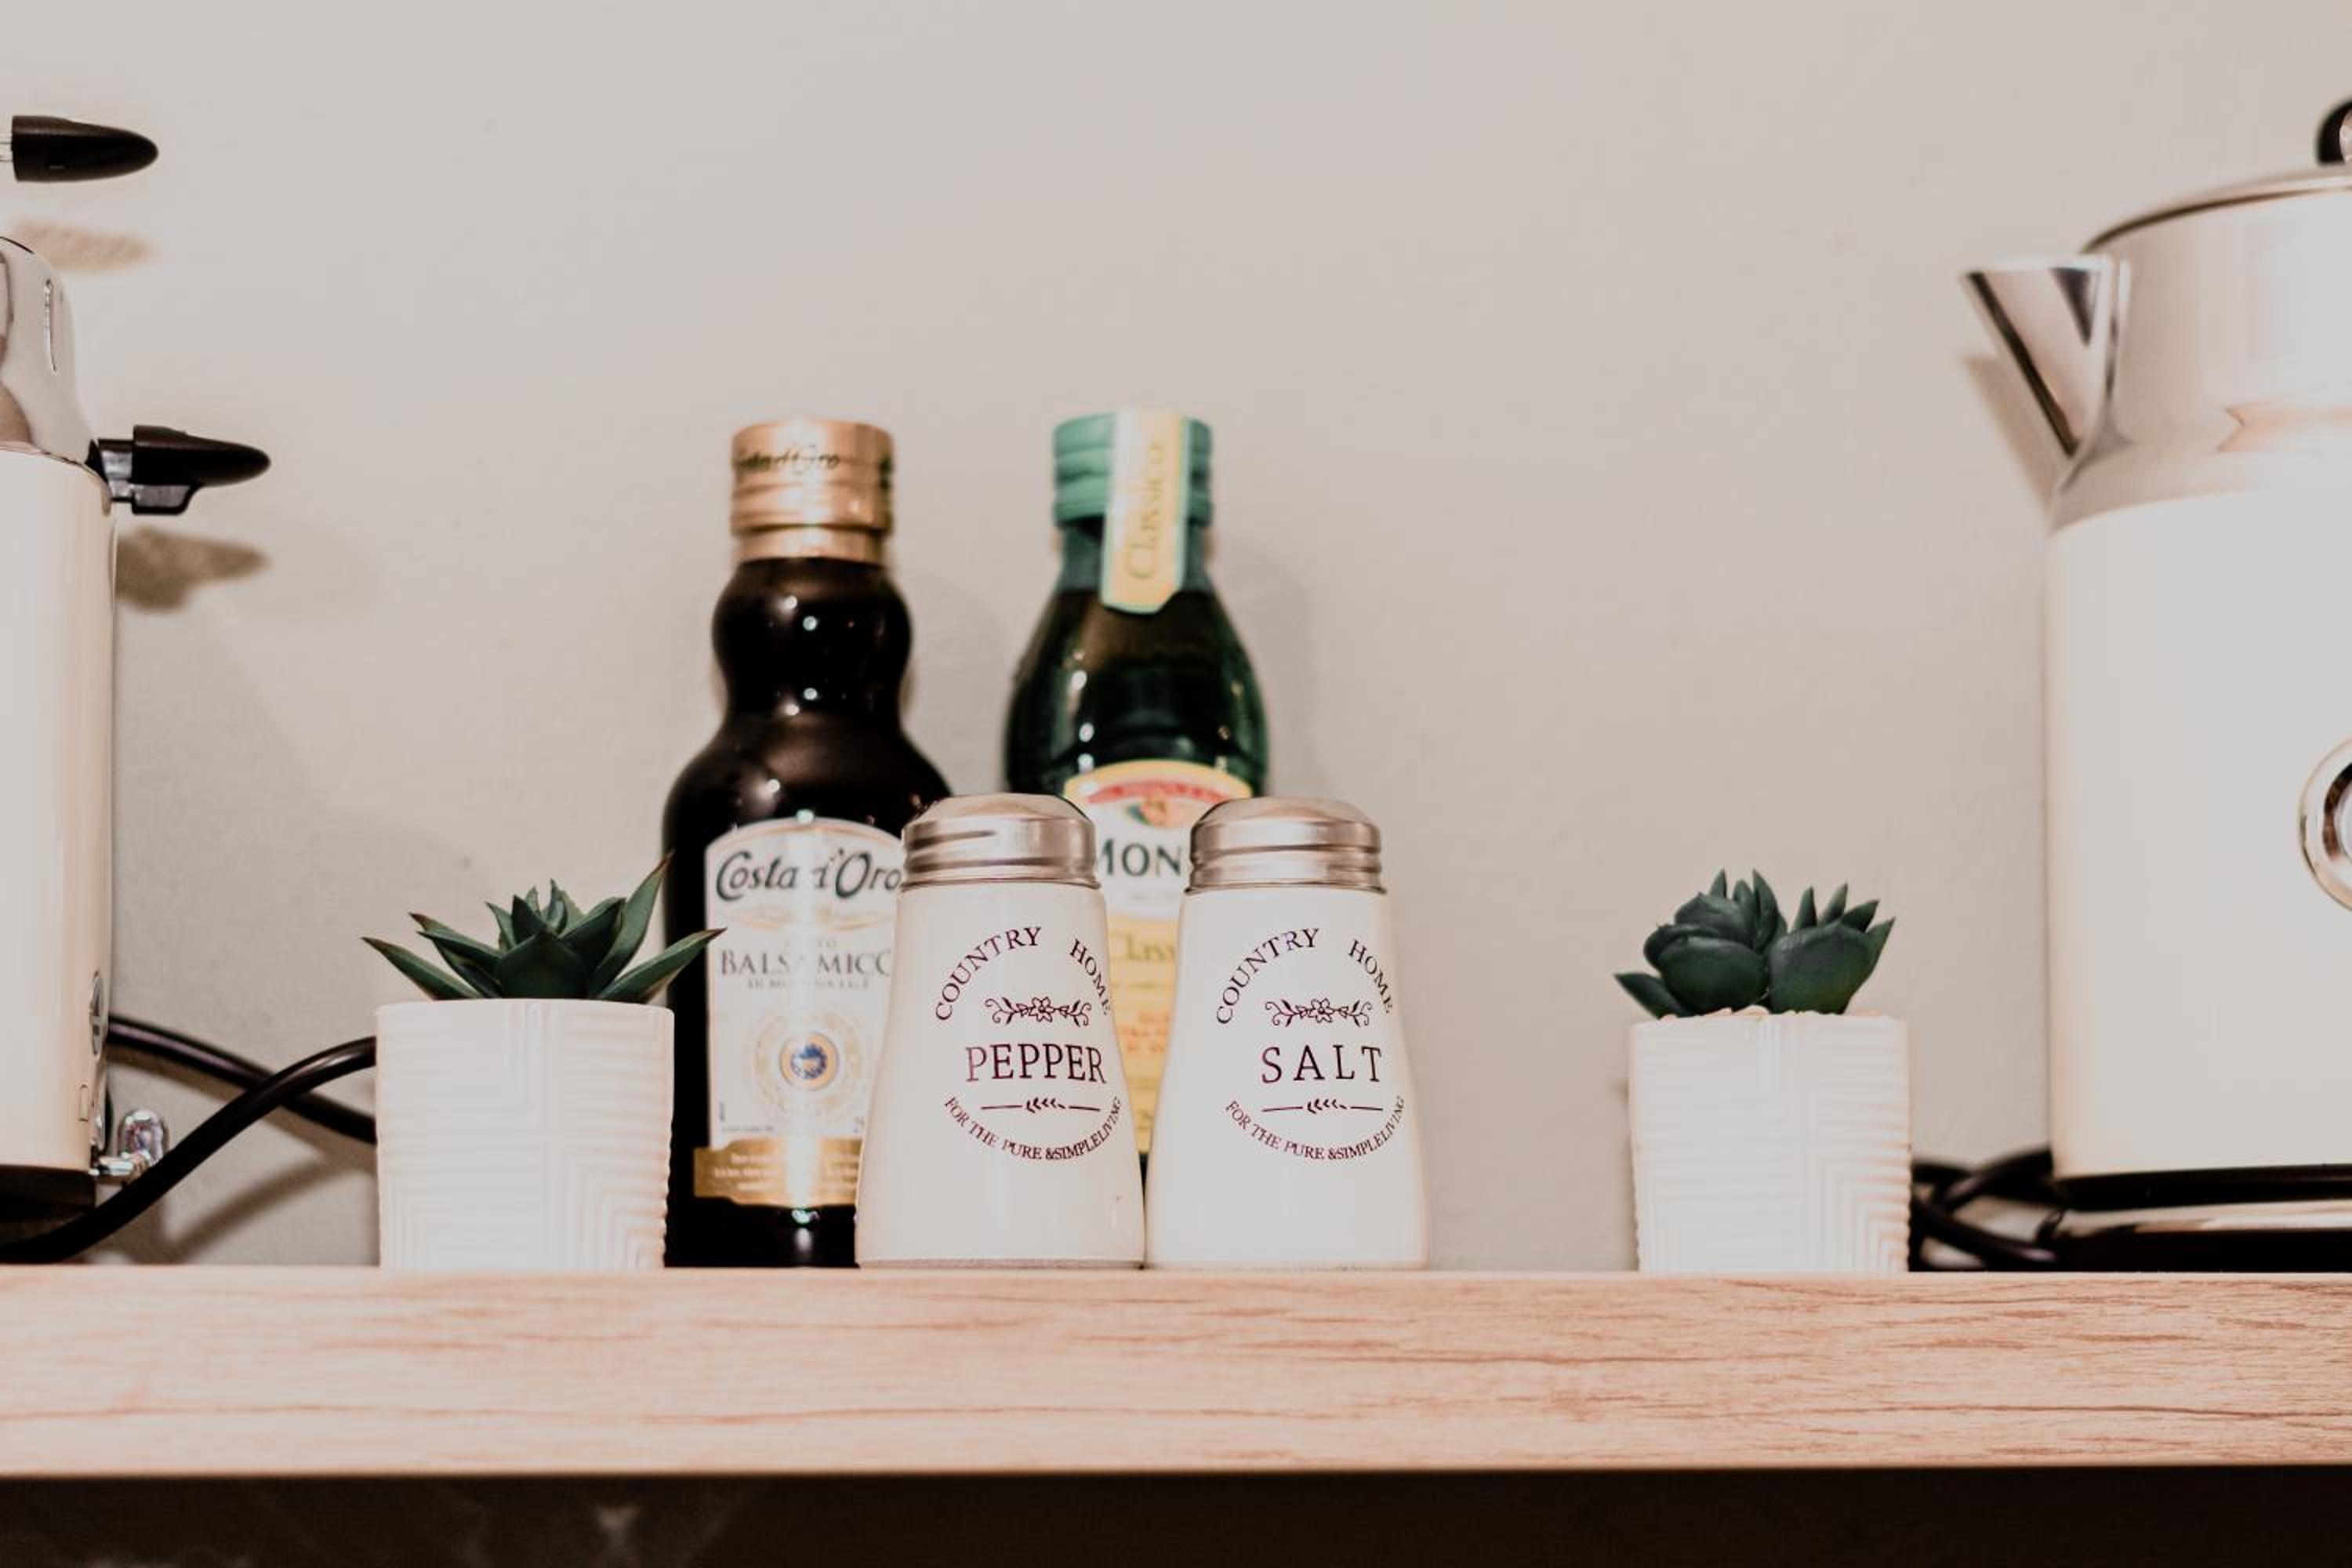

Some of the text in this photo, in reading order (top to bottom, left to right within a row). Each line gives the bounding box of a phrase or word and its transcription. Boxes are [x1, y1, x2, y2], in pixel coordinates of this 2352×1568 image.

[715, 849, 800, 902] Costa
[935, 927, 1111, 1020] COUNTRY HOME
[1216, 928, 1393, 1025] COUNTRY HOME
[965, 1044, 1107, 1083] PEPPER
[1261, 1044, 1382, 1083] SALT
[945, 1097, 970, 1127] FOR
[969, 1121, 999, 1148] THE
[1002, 1139, 1042, 1160] PURE
[1225, 1100, 1251, 1129] FOR
[1251, 1123, 1282, 1149] THE
[1283, 1140, 1325, 1160] PURE
